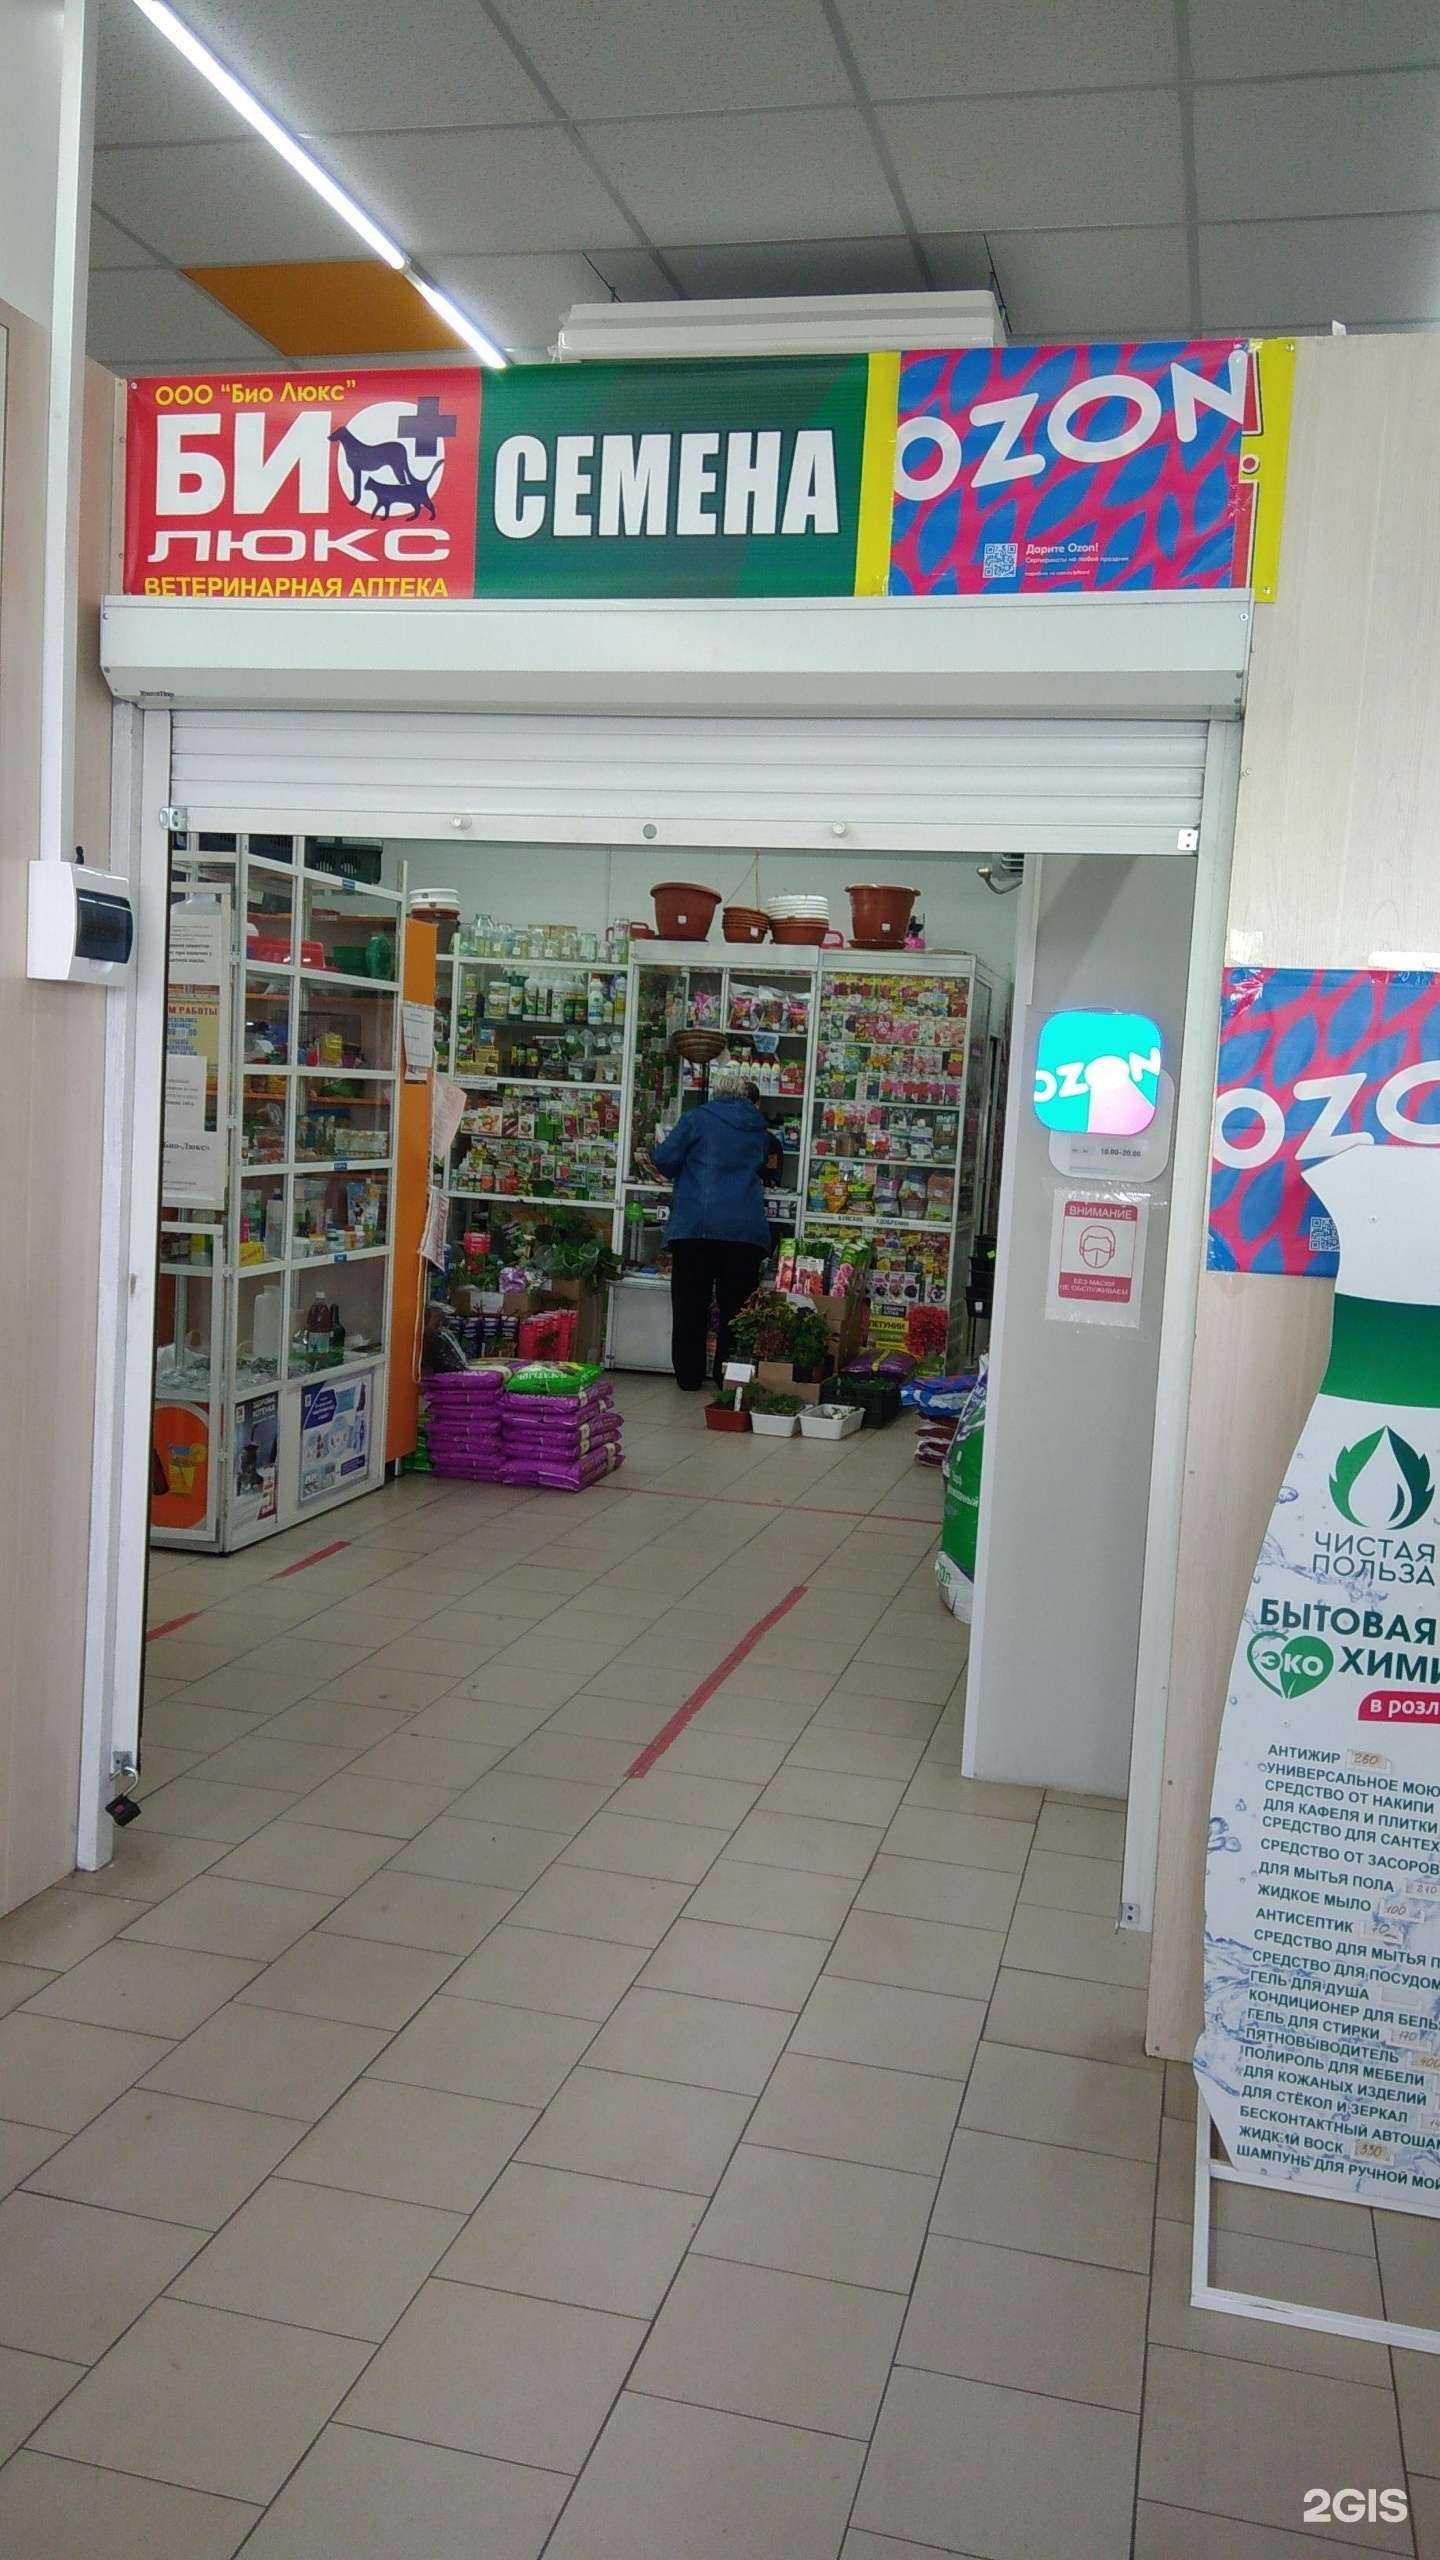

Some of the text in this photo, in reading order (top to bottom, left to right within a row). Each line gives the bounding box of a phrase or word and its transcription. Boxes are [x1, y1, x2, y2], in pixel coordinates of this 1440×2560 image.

[155, 385, 213, 406] ООО
[894, 349, 1248, 500] OZON
[494, 430, 839, 539] СЕМЕНА
[147, 529, 450, 563] ЛЮКС
[1026, 542, 1099, 556] Дарите Ozon!
[144, 577, 449, 598] ВЕТЕРИНАРНАЯ АПТЕКА
[1070, 1206, 1133, 1219] ВНИМАНИЕ
[1315, 1531, 1435, 1563] ЧИСТАЯ
[1312, 1554, 1435, 1586] ПОЛЬЗА
[1260, 1598, 1436, 1646] БЫТОВАЯ
[1261, 1650, 1324, 1676] ЭКО
[1268, 1744, 1341, 1764] АНТИЖИР
[1267, 1762, 1398, 1792] УНИВЕРСАЛЬНОЕ
[1265, 1780, 1434, 1814] СРЕДСТВО ОТ НАКИПИ
[1262, 1816, 1341, 1837] СРЕДСТВО
[1345, 1827, 1376, 1843] ДЛЯ
[1263, 1798, 1438, 1834] ДЛЯ КАФЕЛЯ И ПЛИТКИ
[1260, 1838, 1440, 1875] СРЕДСТВО ОТ ЗАСОРОВ
[1258, 1861, 1394, 1892] ДЛЯ МЫТЬЯ ПОЛА
[1257, 1883, 1371, 1912] ЖИДКОЕ МЫЛО
[1256, 1908, 1354, 1934] АНТИСЕПТИК
[1253, 1929, 1333, 1951] СРЕДСТВО
[1336, 1942, 1367, 1957] ДЛЯ
[1371, 1947, 1426, 1966] МЫТЬЯ
[1252, 1951, 1331, 1973] СРЕДСТВО
[1334, 1965, 1365, 1980] ДЛЯ
[1250, 1970, 1370, 2000] ГЕЛЬ ДЛЯ ДУША
[1247, 2008, 1380, 2041] ГЕЛЬ ДЛЯ СТИРКИ
[1248, 1989, 1440, 2031] КОНДИЦИОНЕР ДЛЯ БЕЛЬ
[1246, 2028, 1400, 2064] ПЯТНОВЫВОДИТЕЛЬ
[1244, 2046, 1425, 2087] ПОЛИРОЛЬ ДЛЯ МЕБЕЛИ
[1243, 2065, 1427, 2106] ДЛЯ КОЖАНЫХ ИЗДЕЛИЙ
[1241, 2085, 1408, 2123] ДЛЯ СТЁКОЛ И ЗЕРКАЛ
[1239, 2105, 1368, 2138] БЕСКОНТАКТНЫЙ
[1303, 2137, 1344, 2153] ВОСК
[1236, 2144, 1311, 2168] ШАМПУНЬ
[1313, 2158, 1345, 2173] ДЛЯ
[1348, 2163, 1408, 2185] РУЧНОЙ
